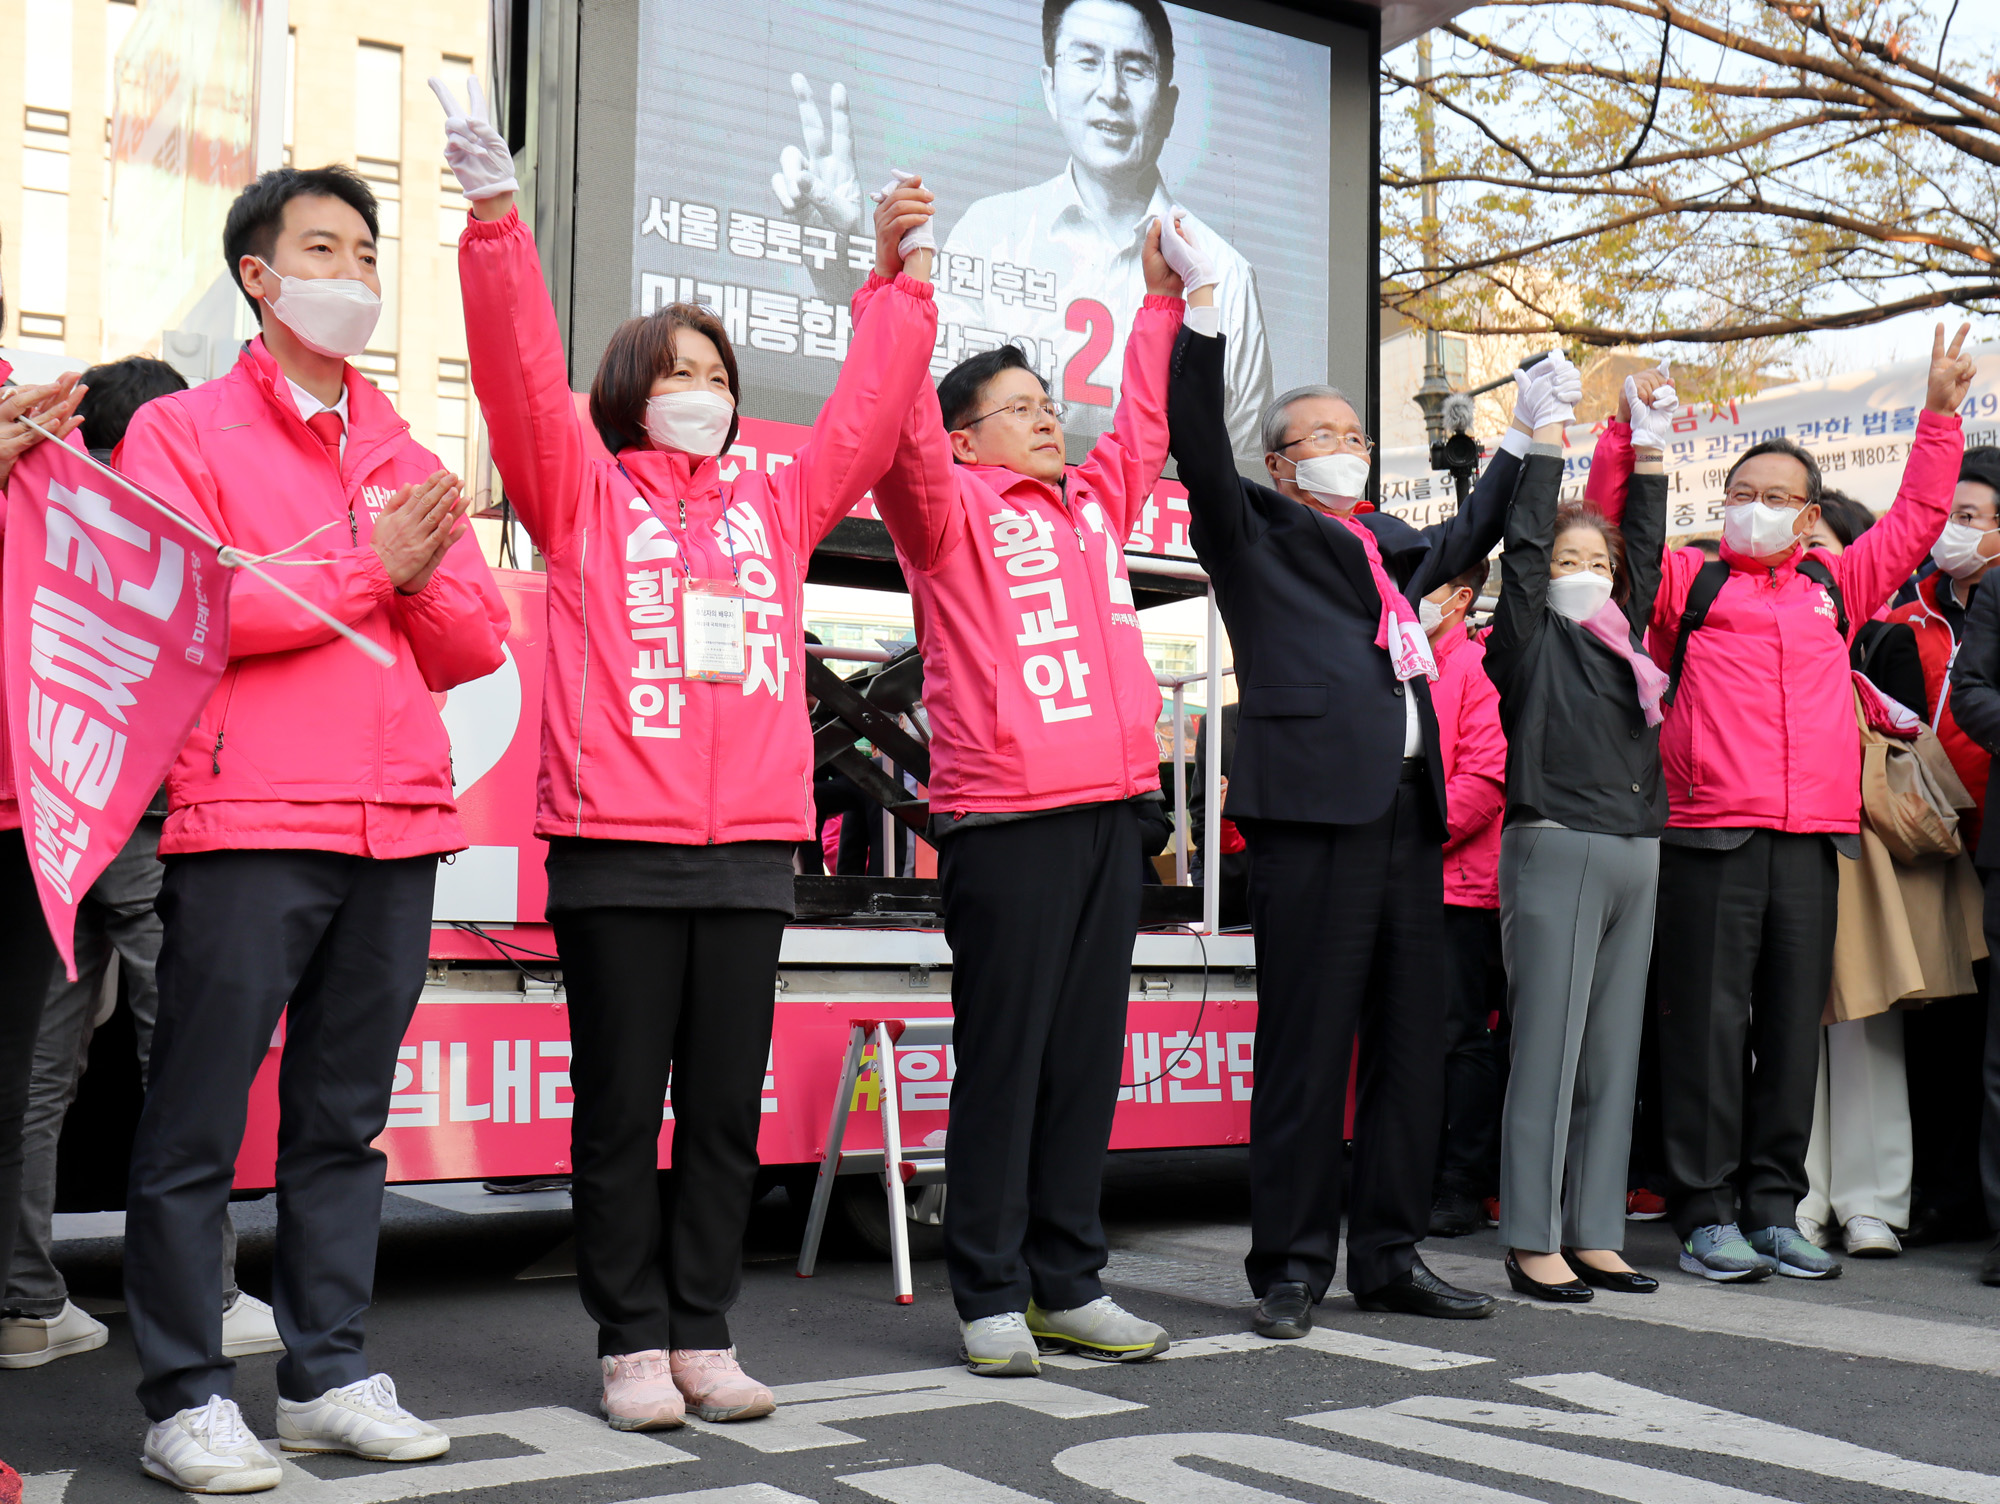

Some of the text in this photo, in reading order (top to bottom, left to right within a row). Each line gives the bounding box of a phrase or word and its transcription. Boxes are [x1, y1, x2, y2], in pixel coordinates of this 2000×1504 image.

[641, 196, 1057, 312] 서울 종로구 국의원 후보
[641, 272, 855, 362] 미래통합
[1063, 297, 1115, 408] 2
[1672, 439, 1695, 464] 및
[1796, 416, 1852, 446] 관한
[1863, 405, 1918, 436] 법률
[1816, 450, 1847, 474] 방법
[1851, 443, 1901, 468] 제80조
[626, 567, 686, 739] 황교안
[712, 501, 790, 702] 배우자
[989, 508, 1093, 723] 황교안
